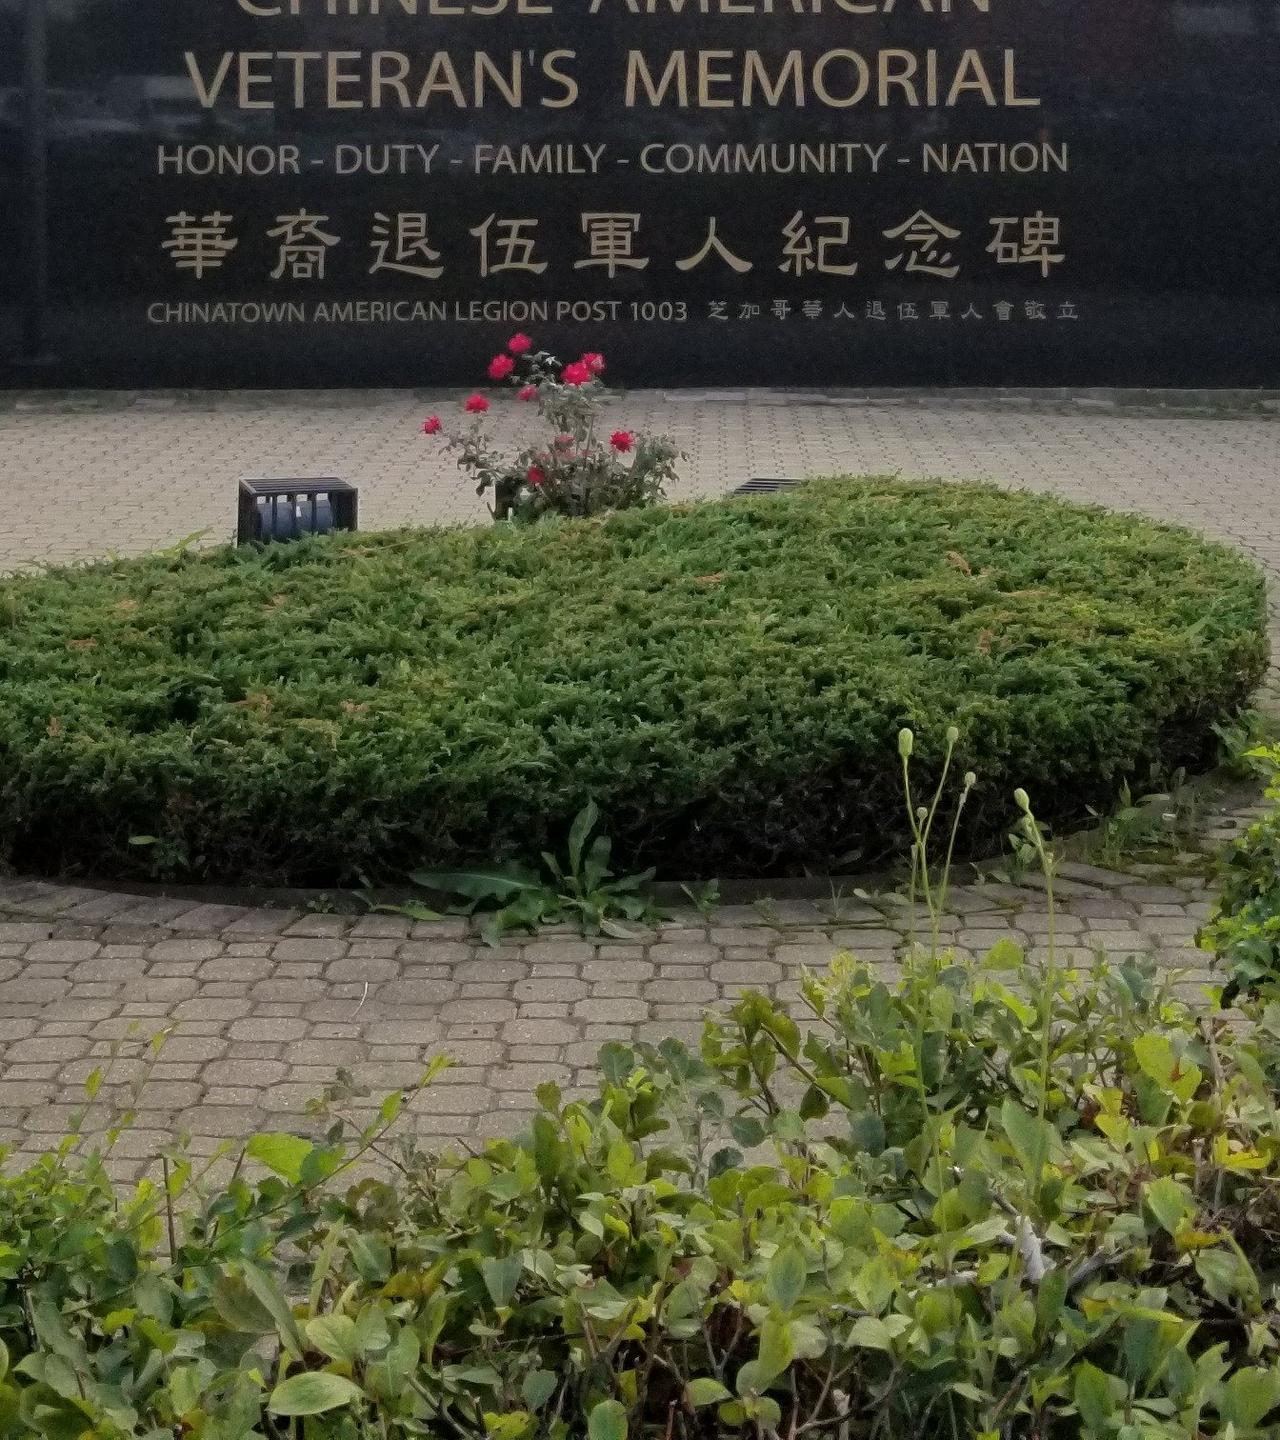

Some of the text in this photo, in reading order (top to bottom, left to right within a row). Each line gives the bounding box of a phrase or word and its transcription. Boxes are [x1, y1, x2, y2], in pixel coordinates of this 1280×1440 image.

[184, 48, 1041, 109] VETERAN'S MEMORIAL
[157, 144, 300, 175] HONOR
[335, 144, 440, 175] DUTY
[474, 143, 607, 174] FAMILY
[640, 143, 887, 173] COMMUNITY
[922, 142, 1068, 173] NATION
[161, 208, 1066, 279] 華裔退伍軍人紀念碑
[147, 300, 688, 323] CHINATOWN AMERICAN LEGION POST 1003
